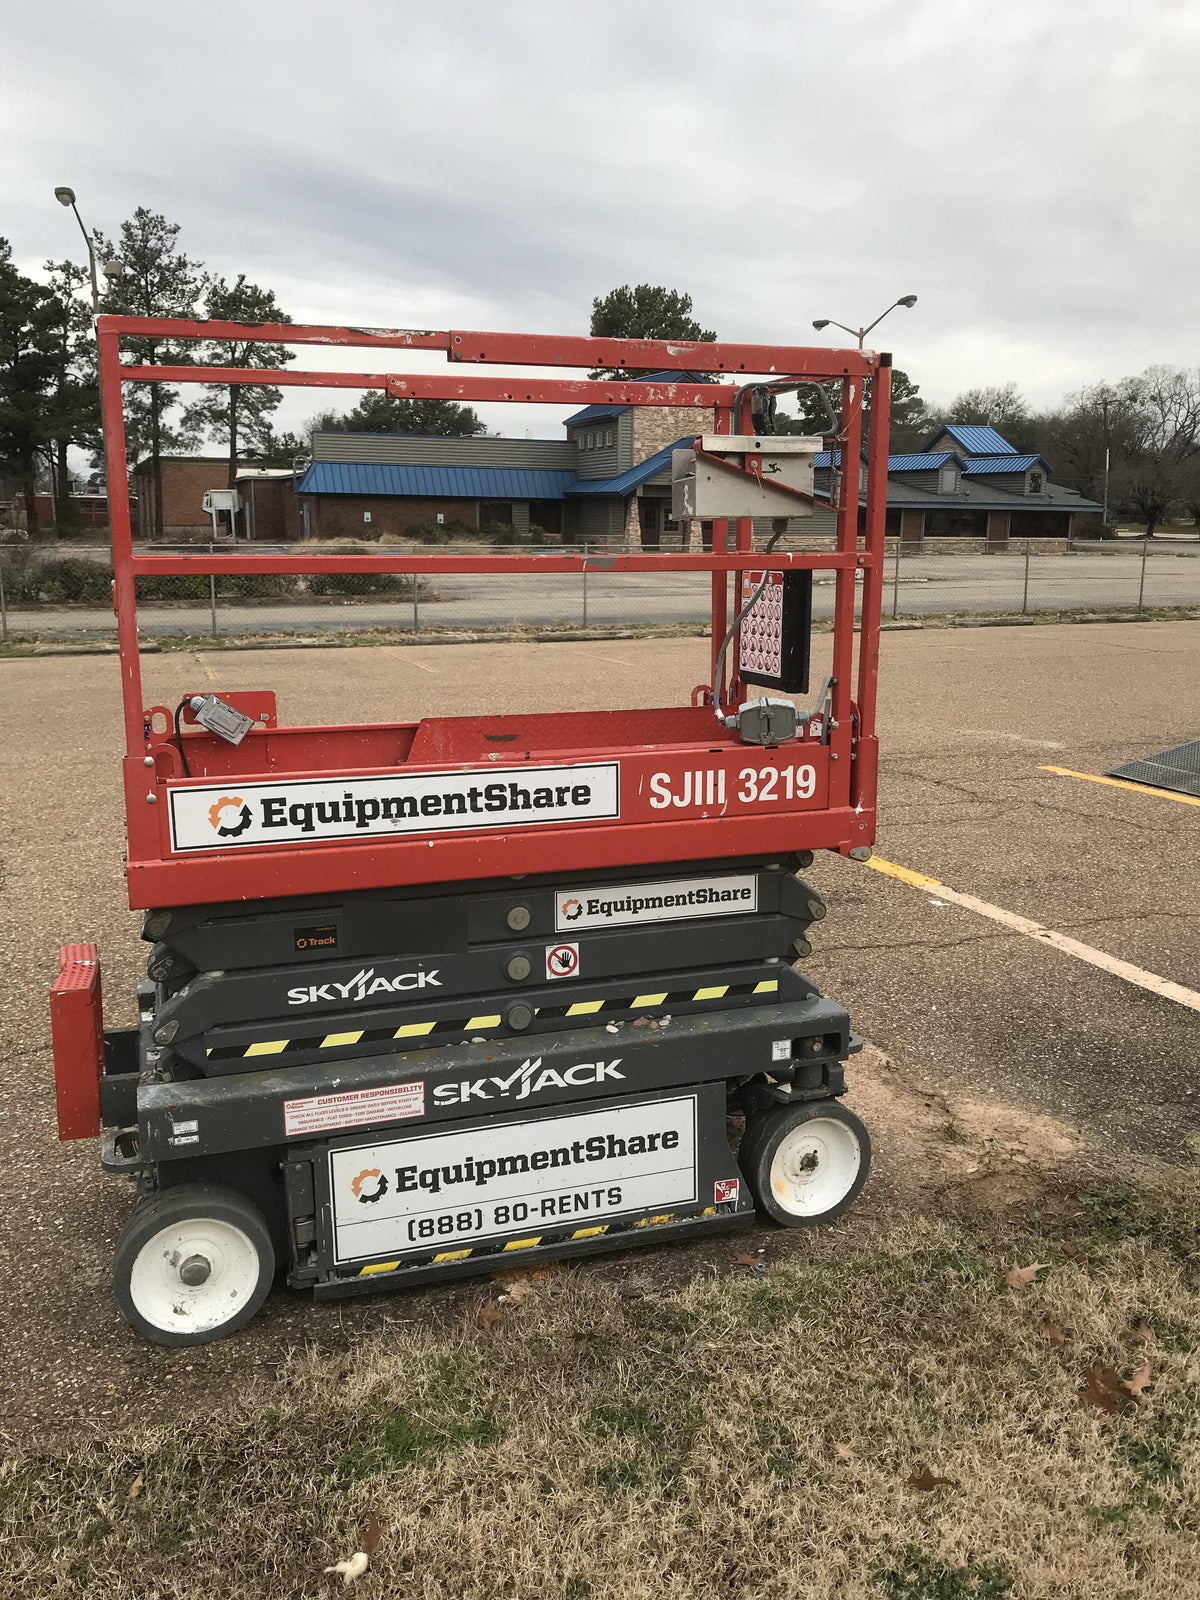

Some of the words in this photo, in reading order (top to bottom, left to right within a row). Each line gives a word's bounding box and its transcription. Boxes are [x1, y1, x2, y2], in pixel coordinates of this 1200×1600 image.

[649, 769, 726, 809] SJIII
[738, 764, 817, 803] 3219
[260, 783, 592, 832] EquipmentShare
[587, 887, 752, 917] EquipmentShare
[309, 936, 336, 946] Track
[287, 968, 443, 1005] SKYJACK
[317, 1094, 359, 1105] CUSTOMER
[360, 1085, 423, 1099] RESPONSIBILITY
[433, 1057, 627, 1106] SKYJACK
[315, 1121, 342, 1129] EQUIPMENT
[364, 1113, 397, 1121] MAINTENANCE
[395, 1130, 679, 1193] EquipmentShare
[407, 1208, 483, 1241] (888)
[494, 1187, 622, 1225] 80-RENTS
